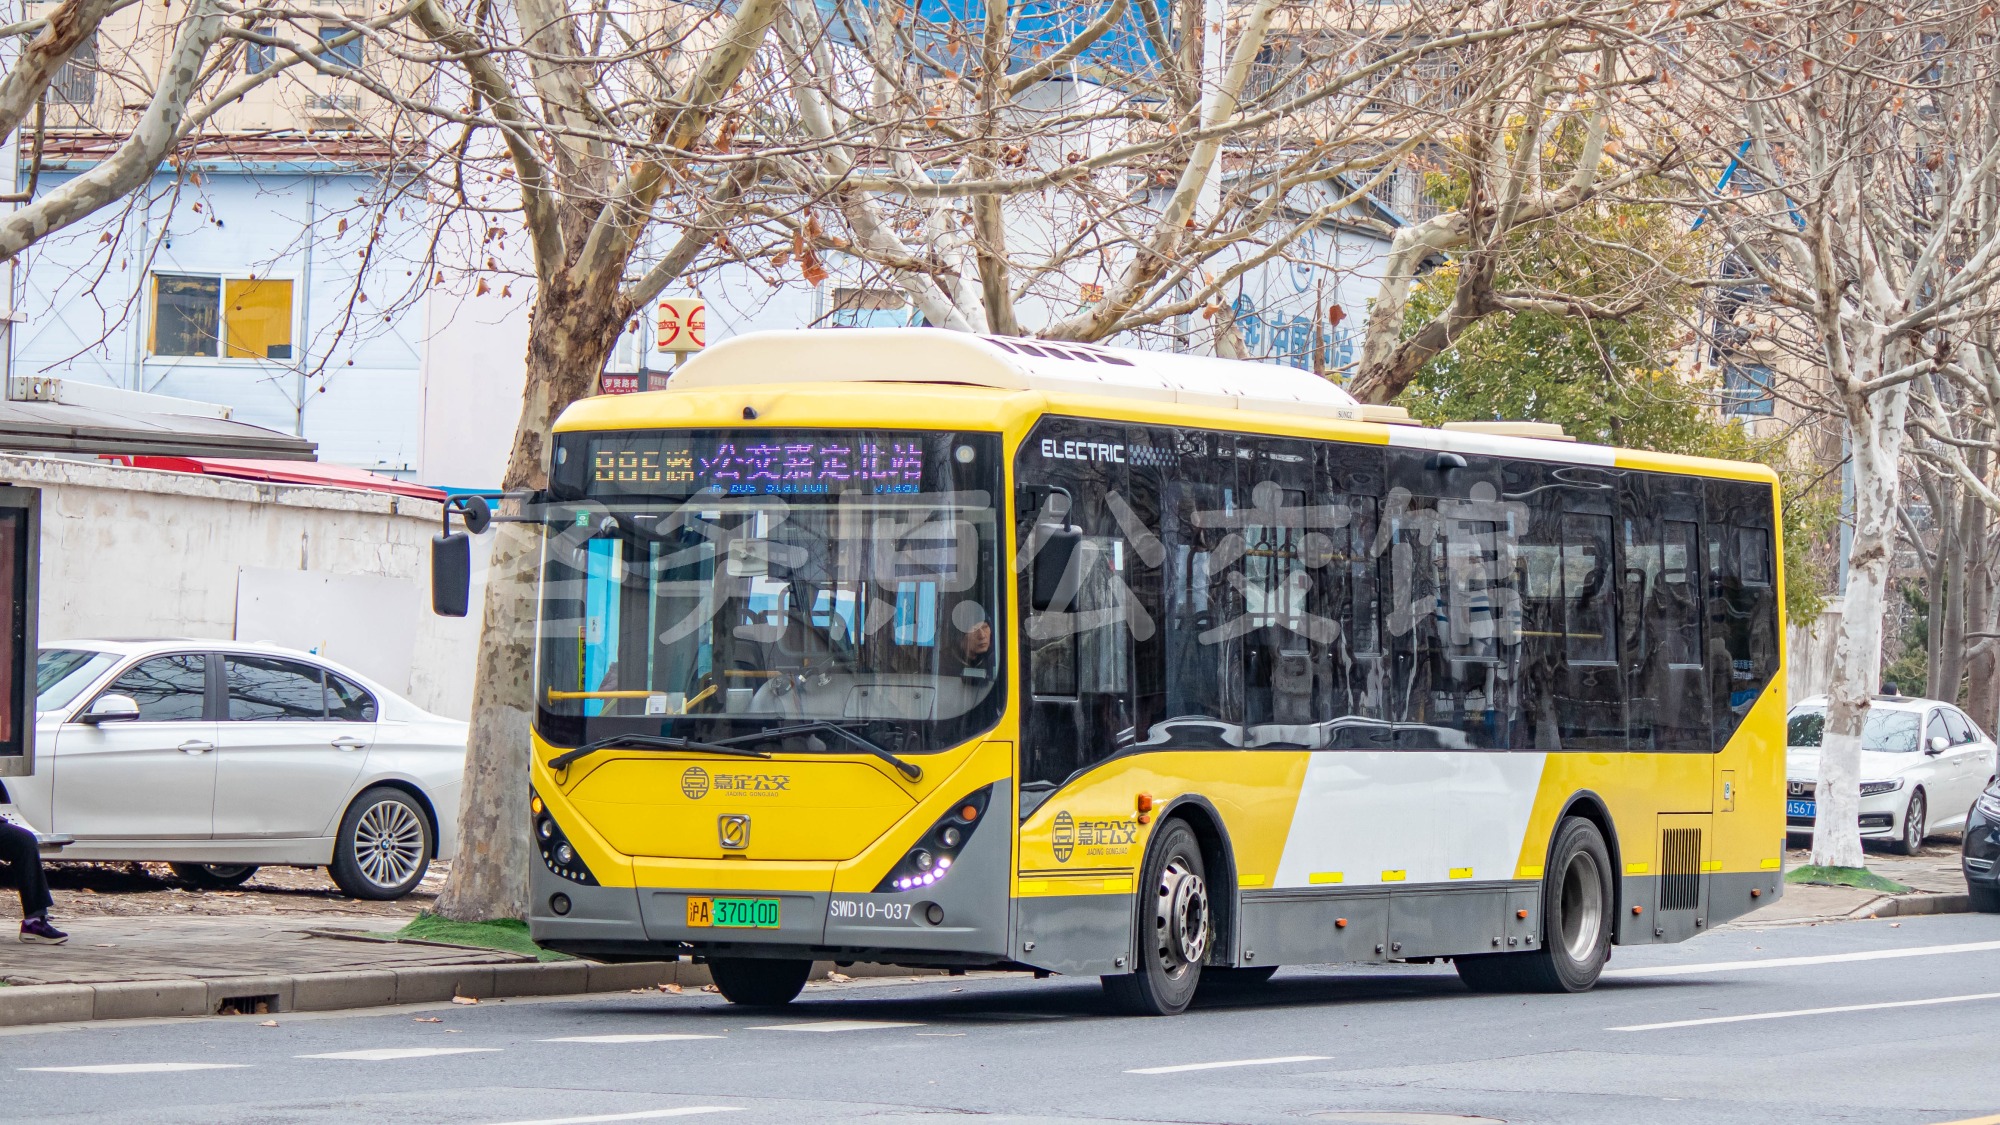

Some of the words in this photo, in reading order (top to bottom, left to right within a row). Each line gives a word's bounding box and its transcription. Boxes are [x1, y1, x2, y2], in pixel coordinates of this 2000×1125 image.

[1041, 438, 1125, 463] ELECTRIC
[713, 774, 791, 791] 嘉定公交
[1078, 820, 1137, 846] 嘉定公交
[830, 900, 912, 920] SWD10-037
